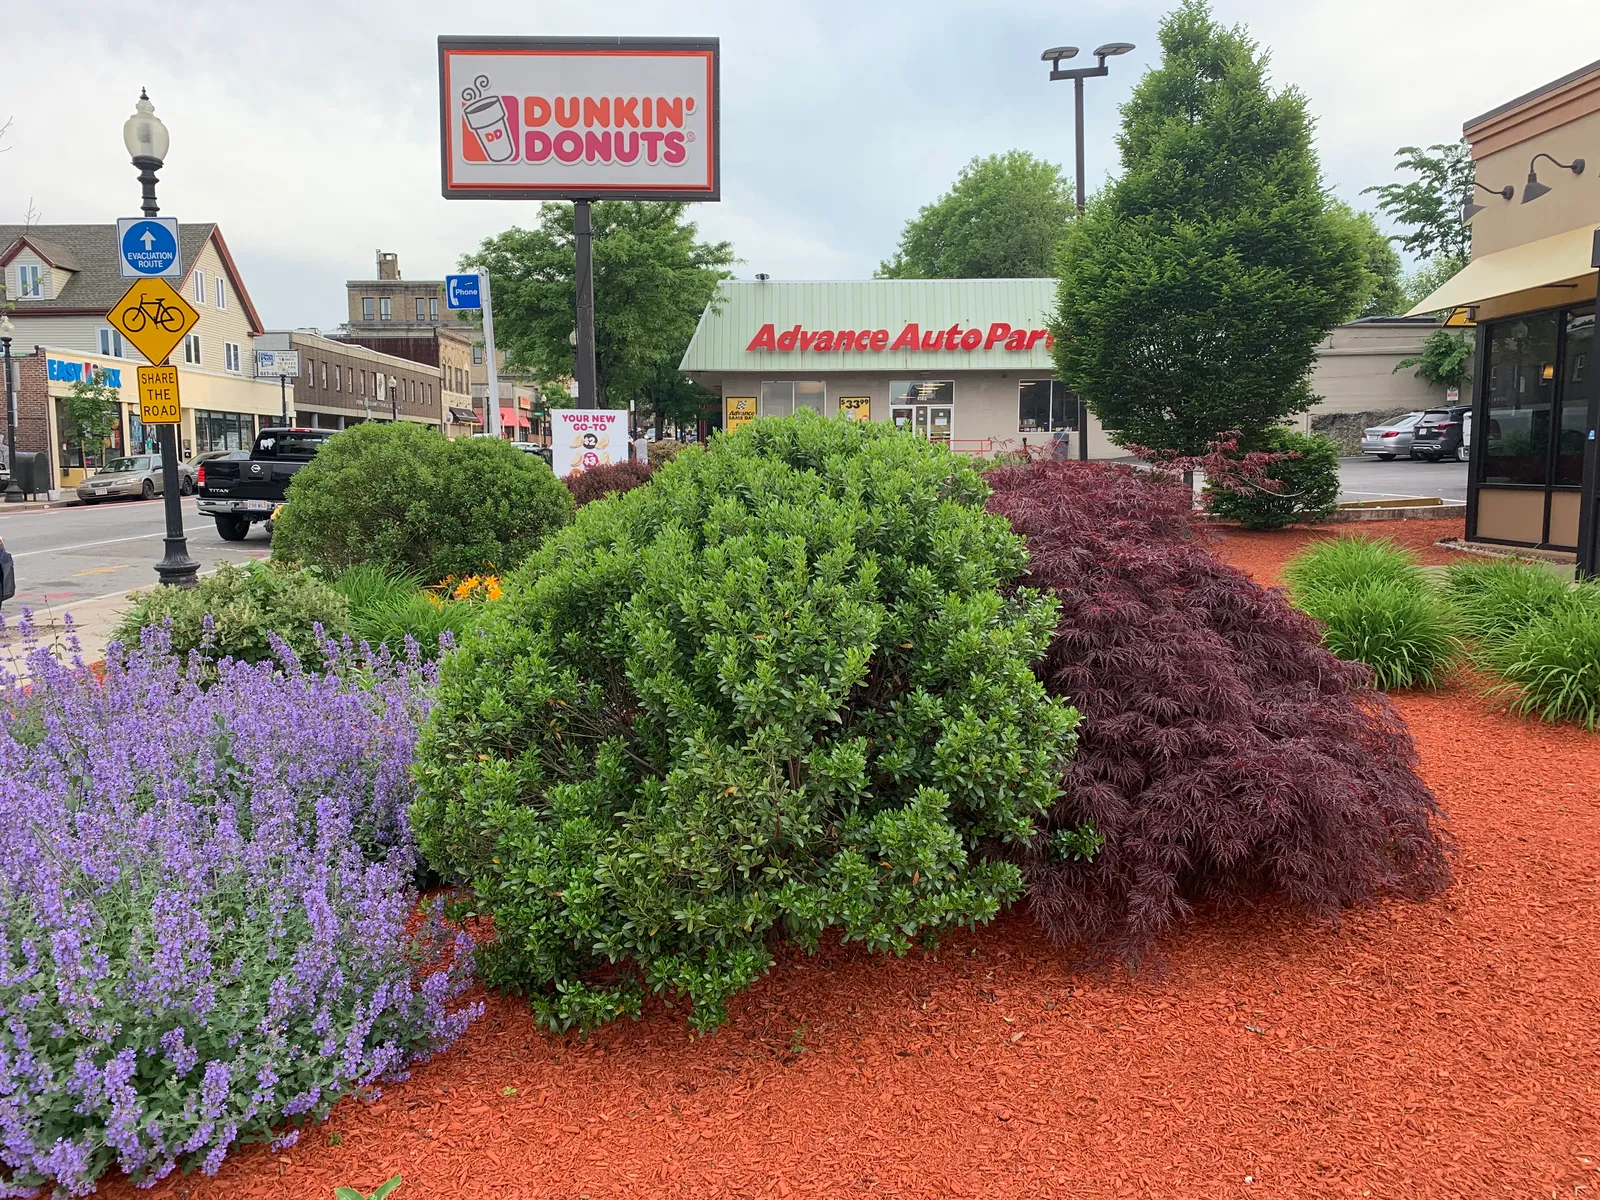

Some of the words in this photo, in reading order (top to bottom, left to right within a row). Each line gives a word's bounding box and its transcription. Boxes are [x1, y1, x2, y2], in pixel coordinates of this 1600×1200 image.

[524, 96, 695, 129] DUNKIN'
[525, 130, 686, 164] DONUTS
[127, 251, 173, 261] EVACUATION
[138, 260, 163, 268] ROUTE
[455, 288, 478, 296] Phone
[745, 323, 890, 352] Advance
[889, 322, 983, 352] Auto
[47, 359, 83, 382] EASY
[141, 372, 175, 384] SHARE
[147, 388, 171, 400] THE
[143, 404, 177, 417] ROAD
[562, 414, 590, 423] YOUR
[591, 414, 616, 423] NEW
[573, 423, 607, 431] GO-TO
[584, 436, 596, 446] $2
[584, 456, 597, 466] $3
